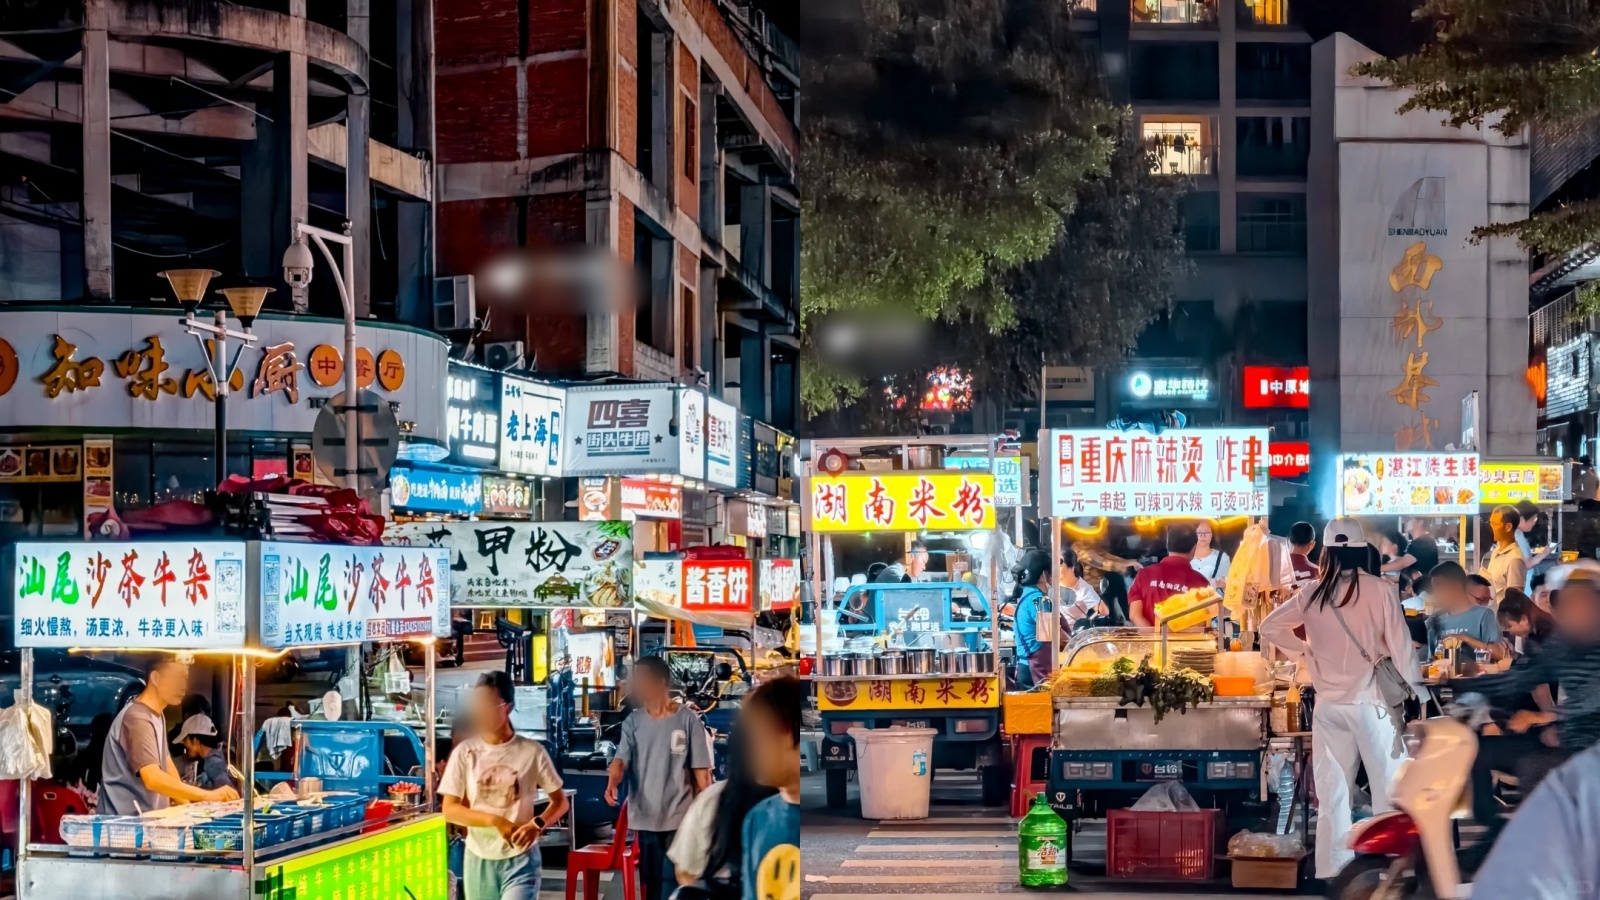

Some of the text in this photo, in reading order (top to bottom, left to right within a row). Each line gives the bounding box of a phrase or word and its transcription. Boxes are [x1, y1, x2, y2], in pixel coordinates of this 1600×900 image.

[41, 333, 304, 405] 知味小厨
[506, 409, 548, 447] 老上海
[587, 399, 650, 429] 四喜
[587, 431, 650, 448] 街头牛排
[1080, 435, 1203, 483] 重庆麻辣烫
[1216, 435, 1262, 483] 炸串
[1388, 457, 1476, 477] 湛江烤生蚝
[815, 479, 990, 525] 湖南米粉
[1058, 492, 1264, 511] 一元一串起 可辣可不辣 可烫可炸
[19, 548, 212, 609] 汕尾沙茶牛杂
[284, 552, 435, 615] 汕尾沙茶牛杂
[686, 566, 749, 605] 酱香饼
[285, 619, 362, 643] 当天现做 味道更好
[869, 680, 994, 704] 湖南米粉
[670, 729, 686, 751] C
[1154, 764, 1178, 774] 台铃
